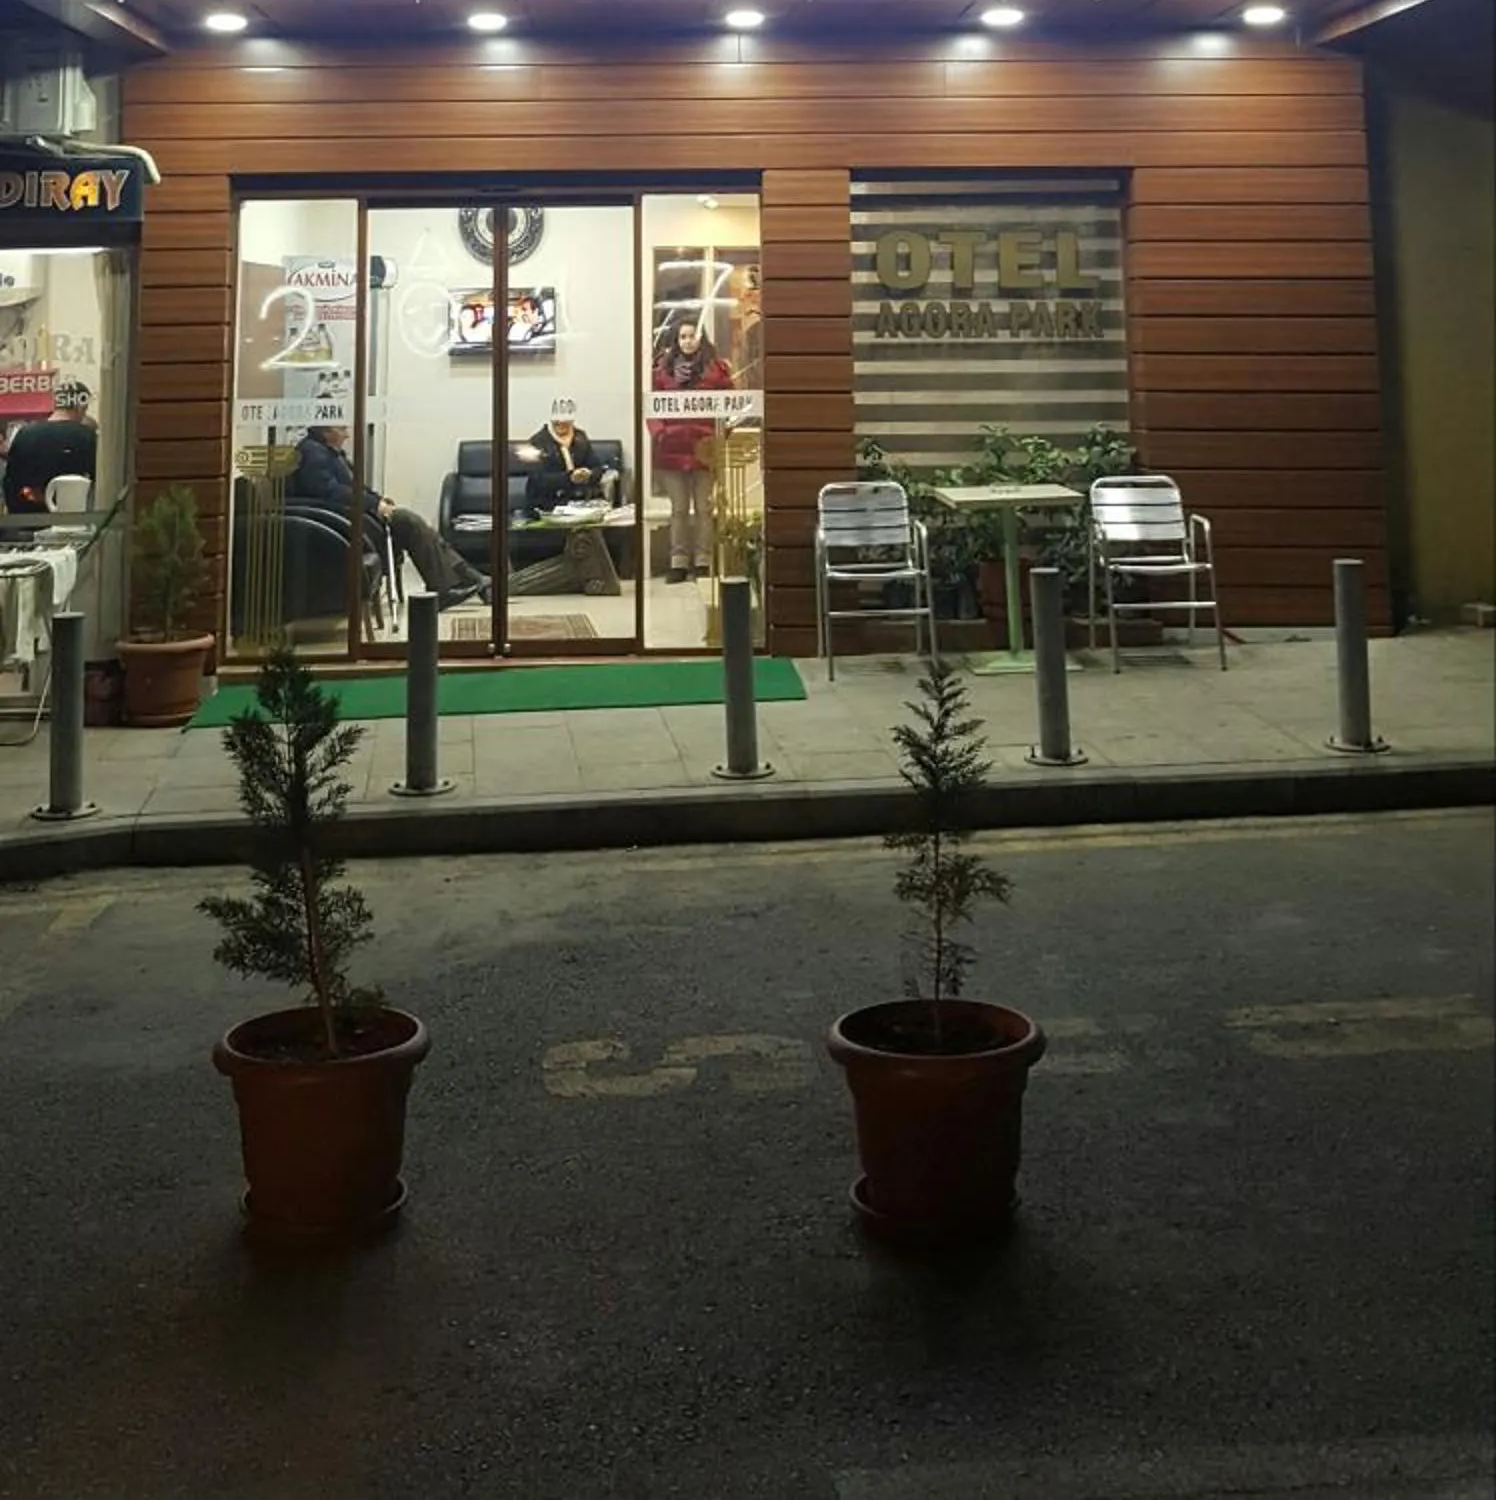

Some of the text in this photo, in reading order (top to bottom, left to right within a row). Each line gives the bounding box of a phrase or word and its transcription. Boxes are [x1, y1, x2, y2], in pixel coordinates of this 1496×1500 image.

[876, 230, 1100, 289] OTEL
[875, 301, 1104, 338] AGORA PARK
[55, 392, 94, 407] SHO
[653, 397, 679, 412] OTEL
